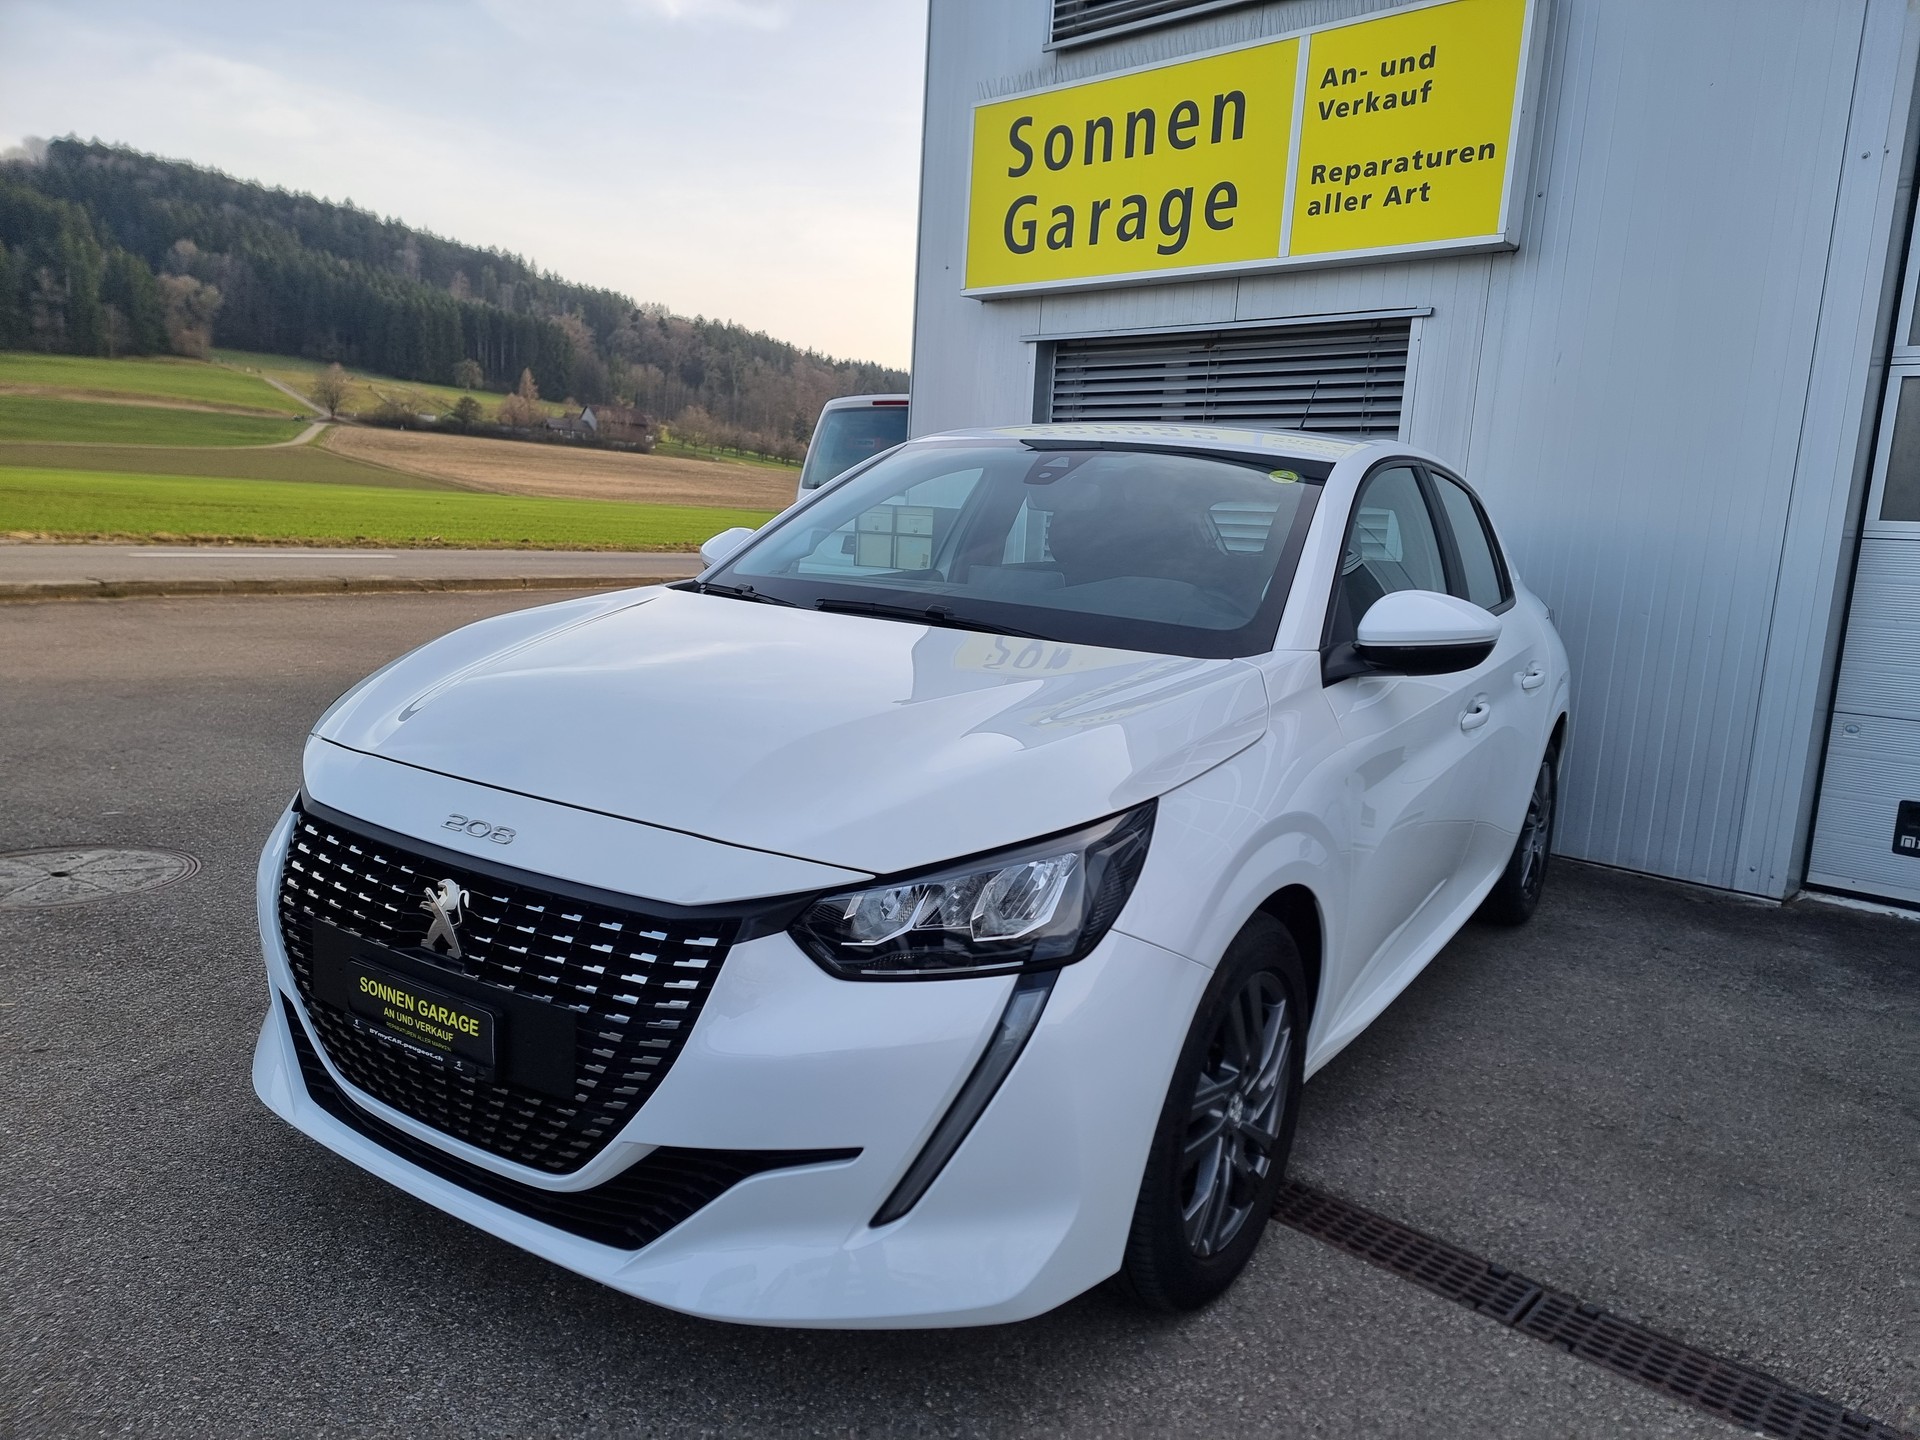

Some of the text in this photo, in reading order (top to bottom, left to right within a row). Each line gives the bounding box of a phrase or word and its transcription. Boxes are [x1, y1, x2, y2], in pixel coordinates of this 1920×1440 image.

[1319, 45, 1437, 90] An- und
[1318, 80, 1433, 121] Verkauf
[1007, 90, 1246, 178] Sonnen
[1310, 141, 1496, 186] Reparaturen
[1003, 178, 1238, 256] Garage
[1307, 182, 1431, 217] aller Art
[440, 813, 517, 845] 208
[359, 976, 480, 1037] SONNEN GARAGE
[383, 1007, 454, 1043] AN UND VERKAUF
